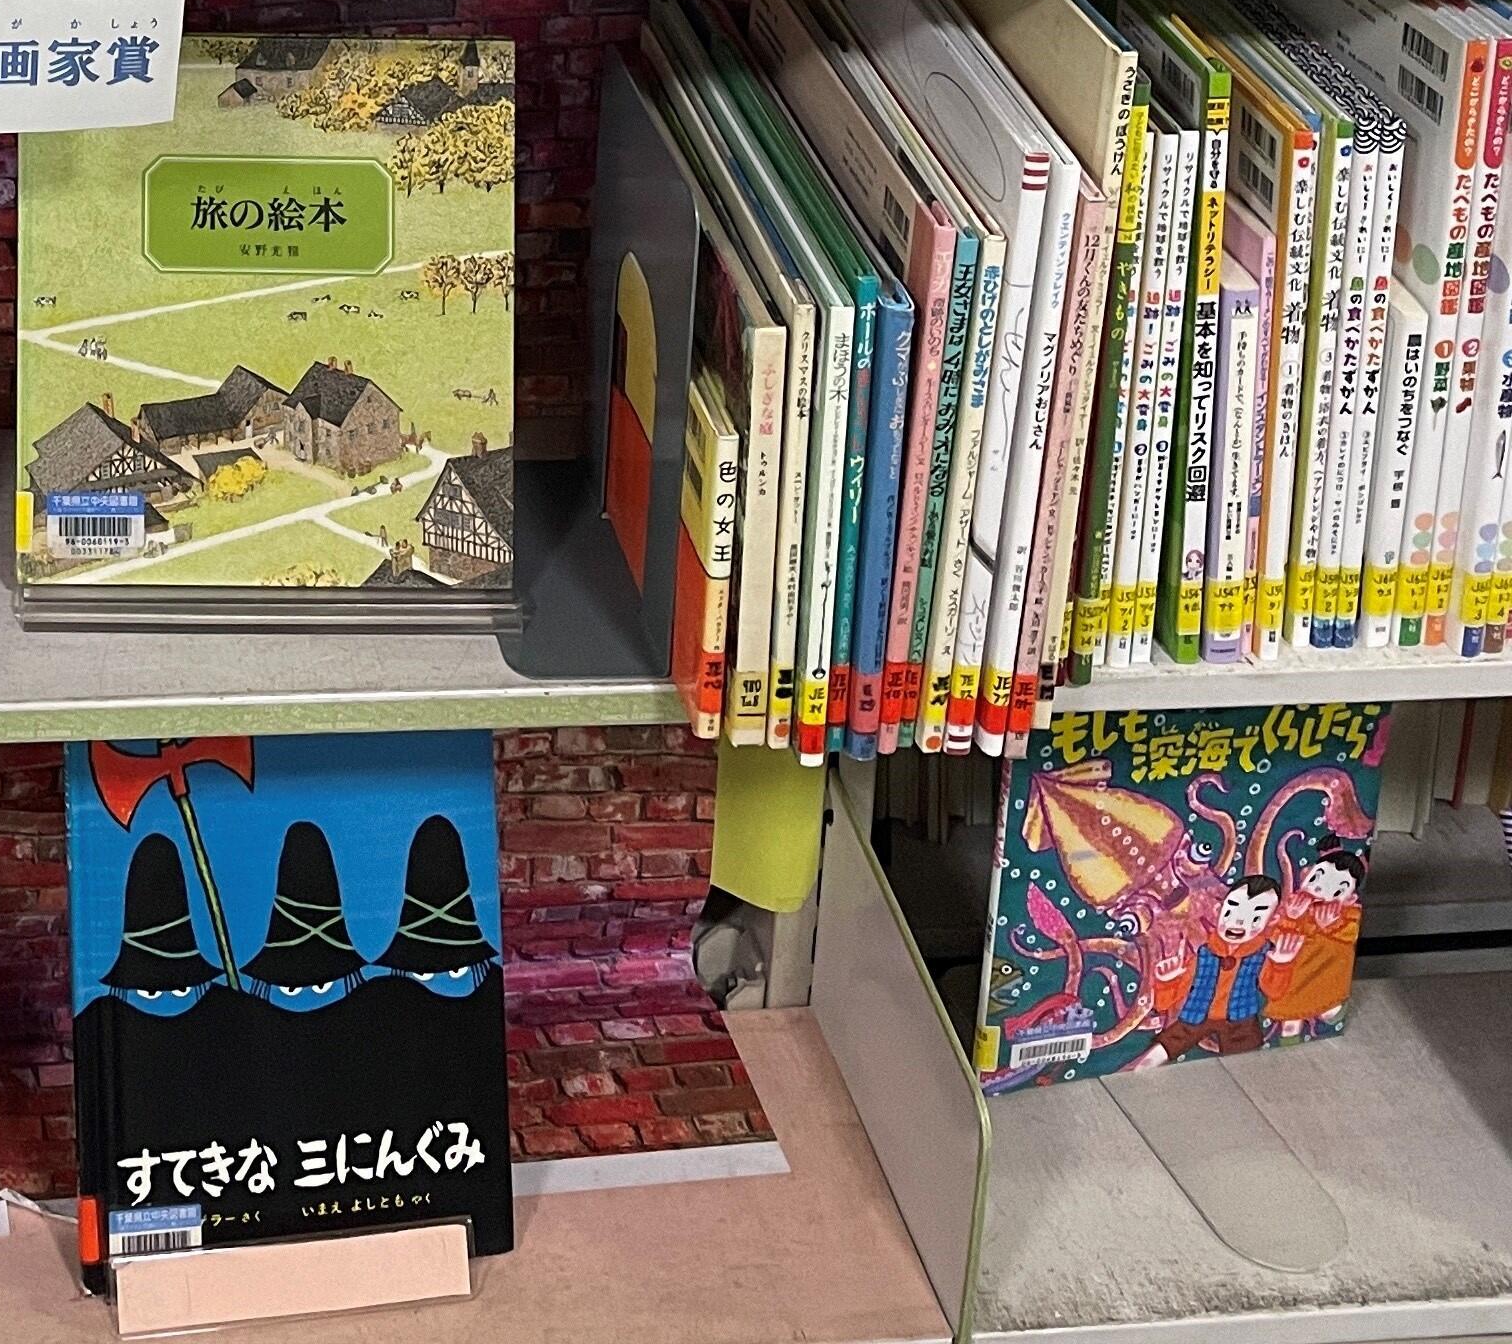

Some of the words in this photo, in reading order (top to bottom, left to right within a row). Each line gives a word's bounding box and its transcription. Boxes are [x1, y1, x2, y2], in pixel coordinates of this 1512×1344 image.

[1116, 66, 1136, 120] うさぎの
[1110, 123, 1128, 176] ぼうけん
[190, 196, 348, 233] 旅の絵本
[1154, 154, 1172, 280] リサイクルで地球を救う
[1176, 153, 1194, 276] リサイクルで地球を救う
[1203, 198, 1220, 290] ネットリテラシー
[1289, 178, 1308, 292] 楽しむ伝統文化
[1329, 167, 1351, 280] 楽しむ伝統文化
[971, 265, 1001, 409] 赤ひげのとしがみさま
[1111, 261, 1132, 341] やきもの
[1280, 303, 1302, 345] 着物
[758, 362, 777, 436] ふしぎな庭
[795, 330, 812, 420] クリスマスの絵本
[828, 333, 851, 401] まほうの木
[1029, 332, 1057, 450] マグノリアおじさん
[1186, 302, 1217, 502] 基本を知ってリスク回避
[51, 495, 139, 508] 千葉県立中央図書館
[711, 460, 737, 563] 色の女王
[117, 1137, 277, 1206] すてきな
[294, 1120, 486, 1190] 三にんぐみ
